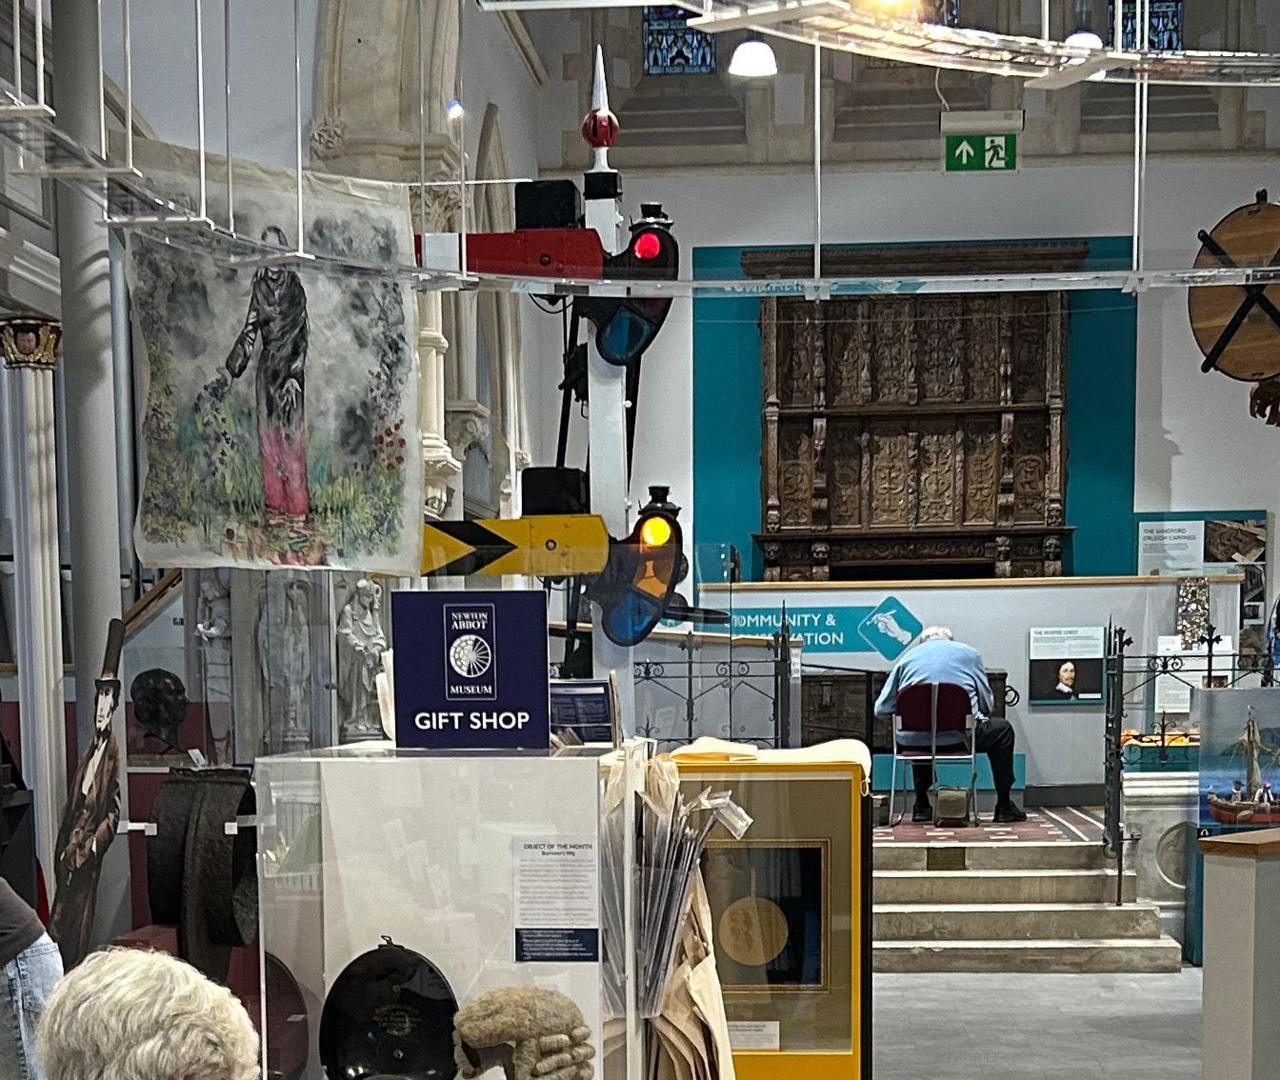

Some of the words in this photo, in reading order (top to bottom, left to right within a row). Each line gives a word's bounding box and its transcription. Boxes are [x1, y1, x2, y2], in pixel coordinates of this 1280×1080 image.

[451, 612, 488, 620] NEWTON
[825, 614, 836, 627] &
[451, 620, 488, 630] ABBOT
[450, 685, 492, 694] MUSEUM
[414, 711, 464, 730] GIFT
[469, 711, 530, 730] SHOP
